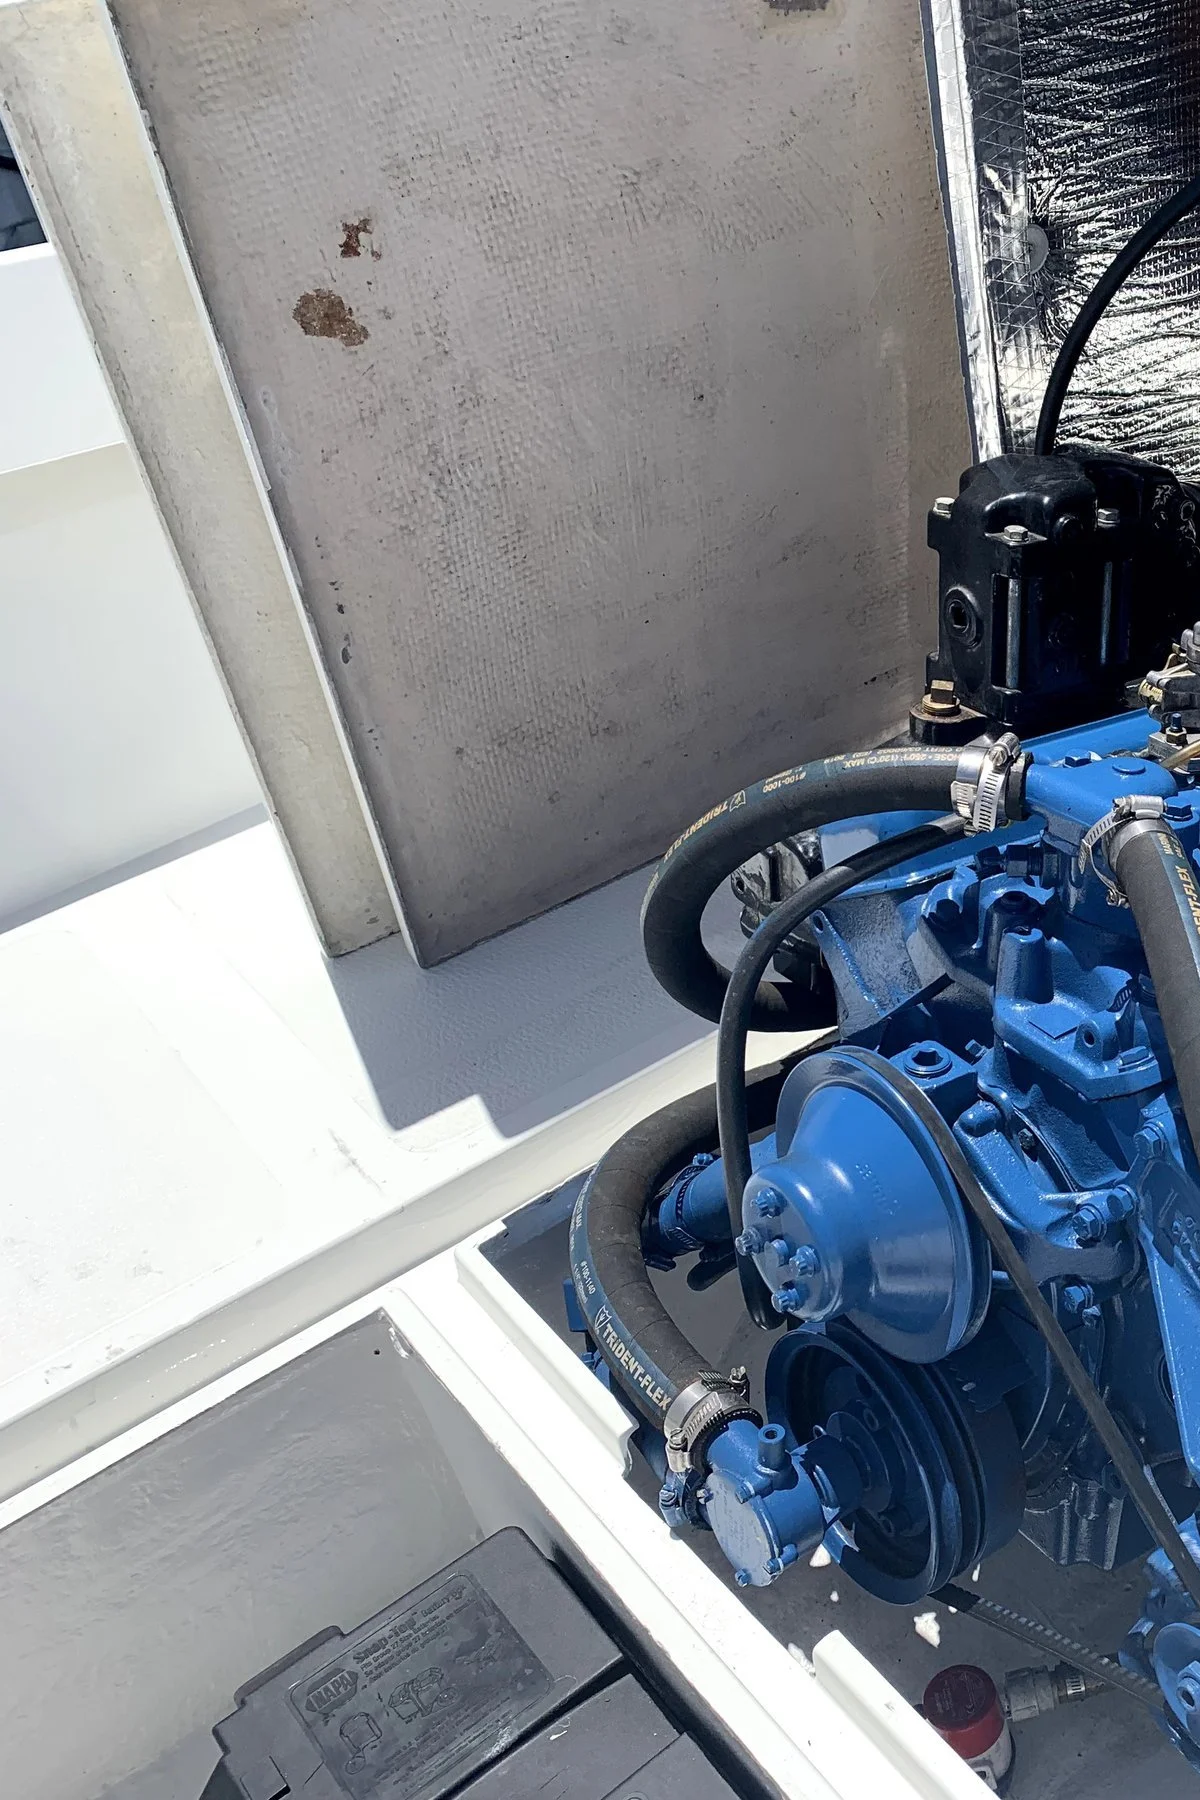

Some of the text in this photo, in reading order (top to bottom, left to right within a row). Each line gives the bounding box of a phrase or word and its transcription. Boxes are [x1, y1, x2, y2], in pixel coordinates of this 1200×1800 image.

[600, 1322, 672, 1411] TRIDENT-FLEX
[420, 1595, 450, 1618] Battery
[370, 1646, 391, 1662] Group
[390, 1639, 400, 1650] 27
[398, 1630, 413, 1644] Size
[411, 1634, 421, 1644] 27
[310, 1672, 353, 1709] NAPA
